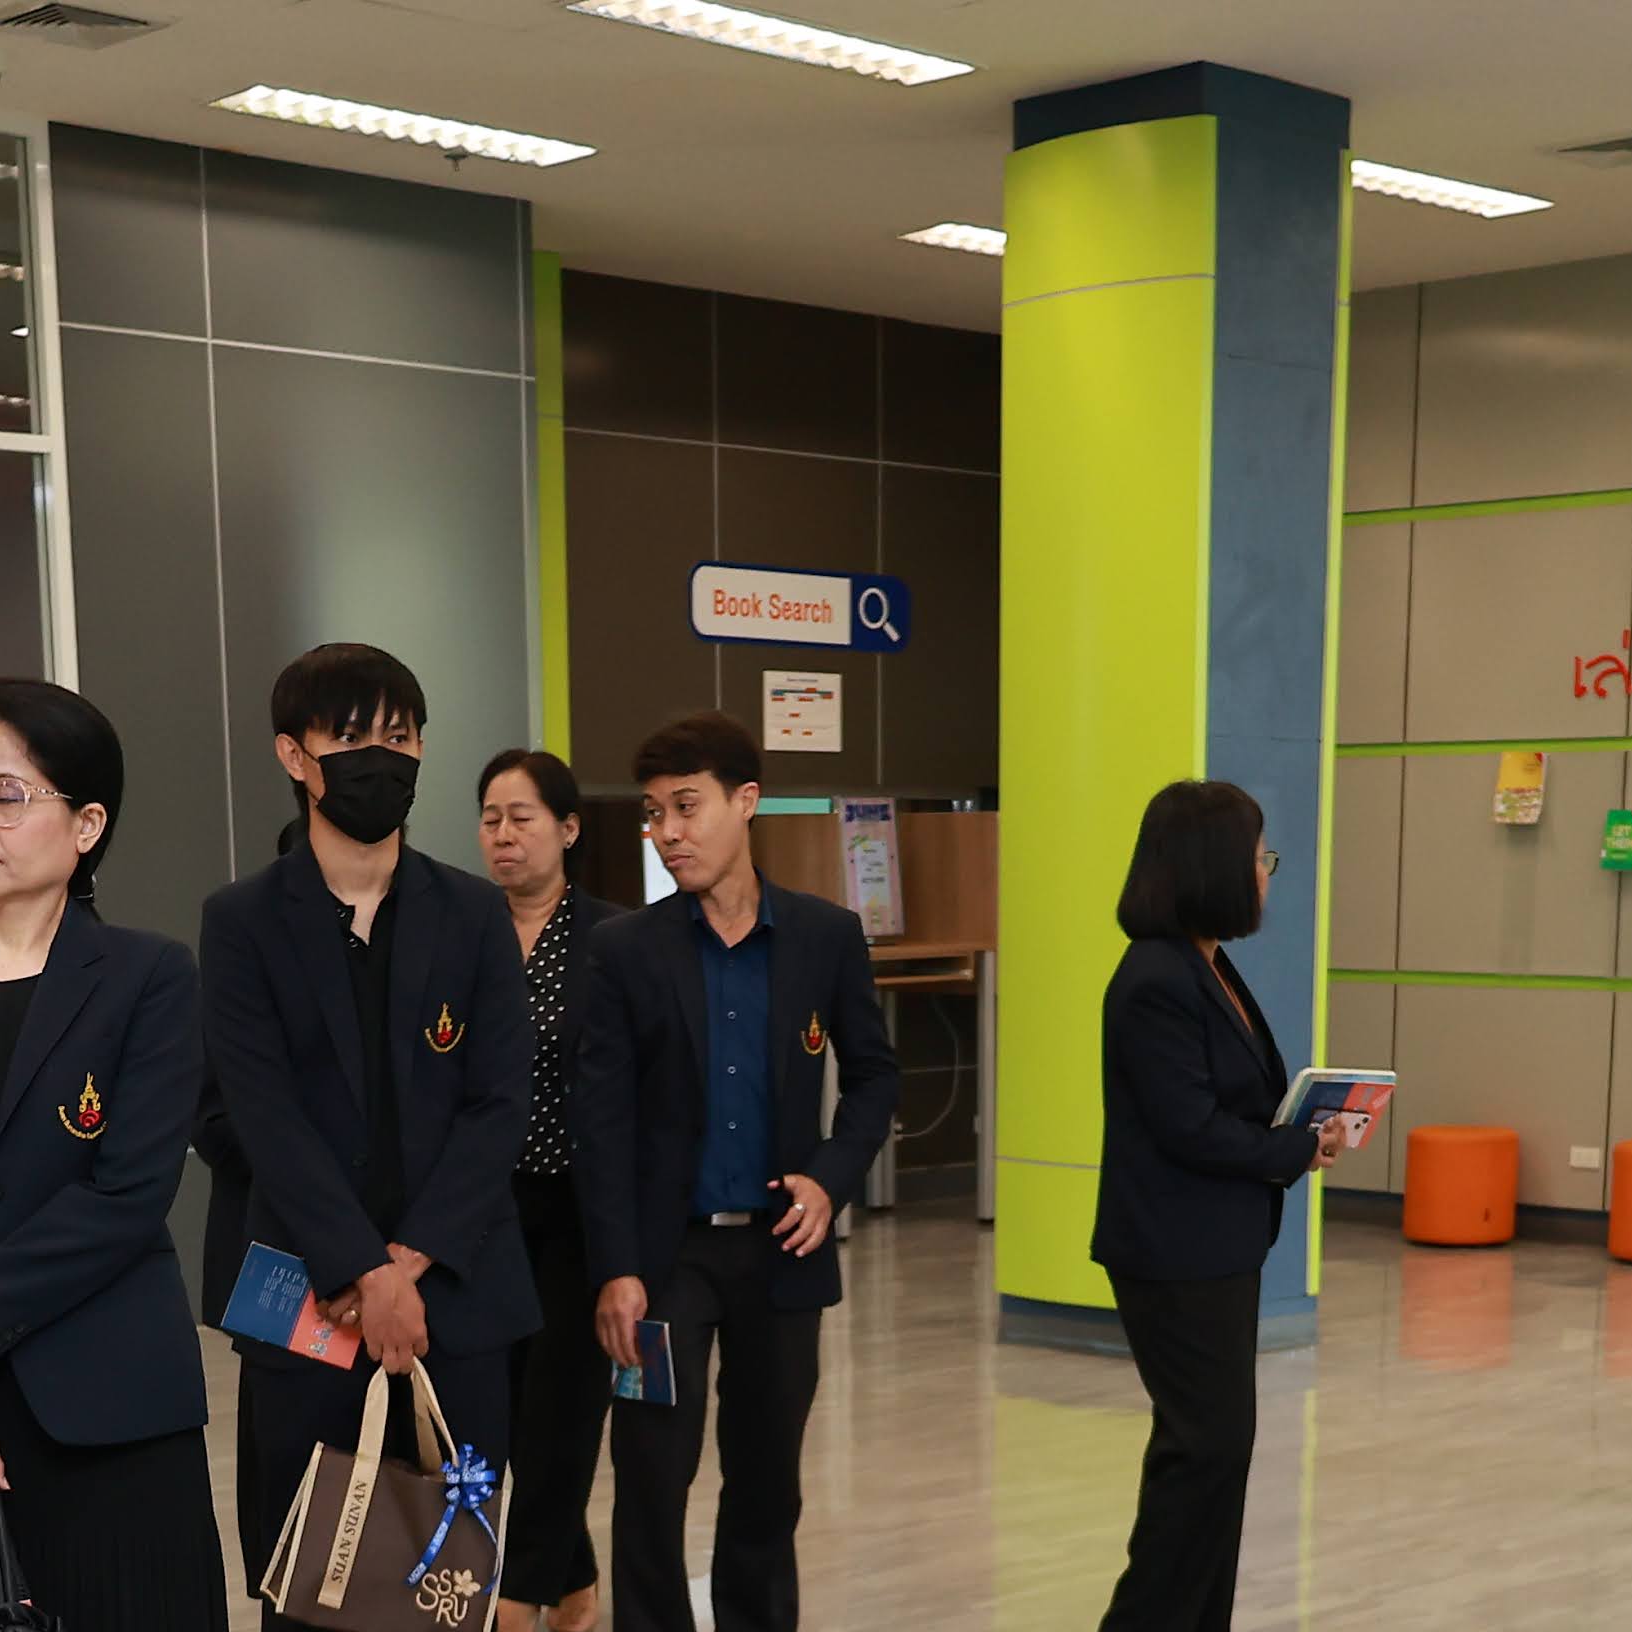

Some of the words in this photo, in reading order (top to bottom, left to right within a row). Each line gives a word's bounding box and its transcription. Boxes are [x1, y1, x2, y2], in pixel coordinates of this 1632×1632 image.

[712, 587, 763, 618] Book
[768, 592, 833, 624] Search
[330, 1537, 353, 1584] SUAN
[343, 1479, 368, 1536] SUNAN
